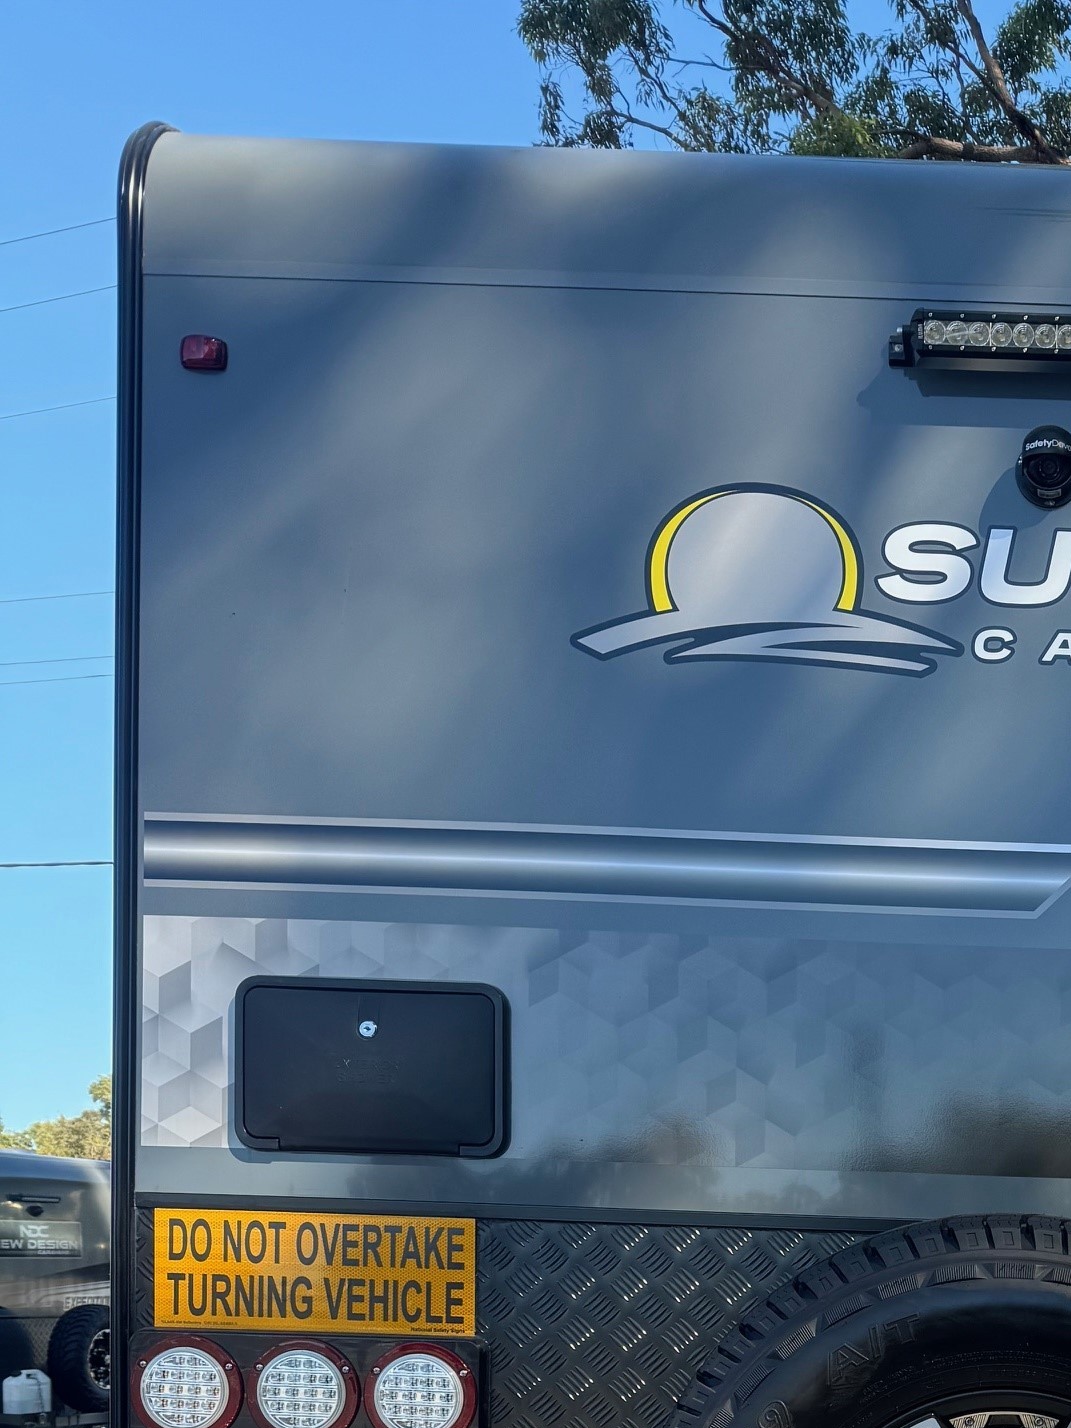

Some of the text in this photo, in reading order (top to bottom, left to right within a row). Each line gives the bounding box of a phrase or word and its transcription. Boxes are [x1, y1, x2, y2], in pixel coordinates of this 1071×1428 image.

[0, 1239, 78, 1250] EW DESIGN
[168, 1218, 466, 1271] DO NOT OVERTAKE
[166, 1273, 465, 1325] TURNING VEHICLE
[824, 1310, 921, 1389] A/T
